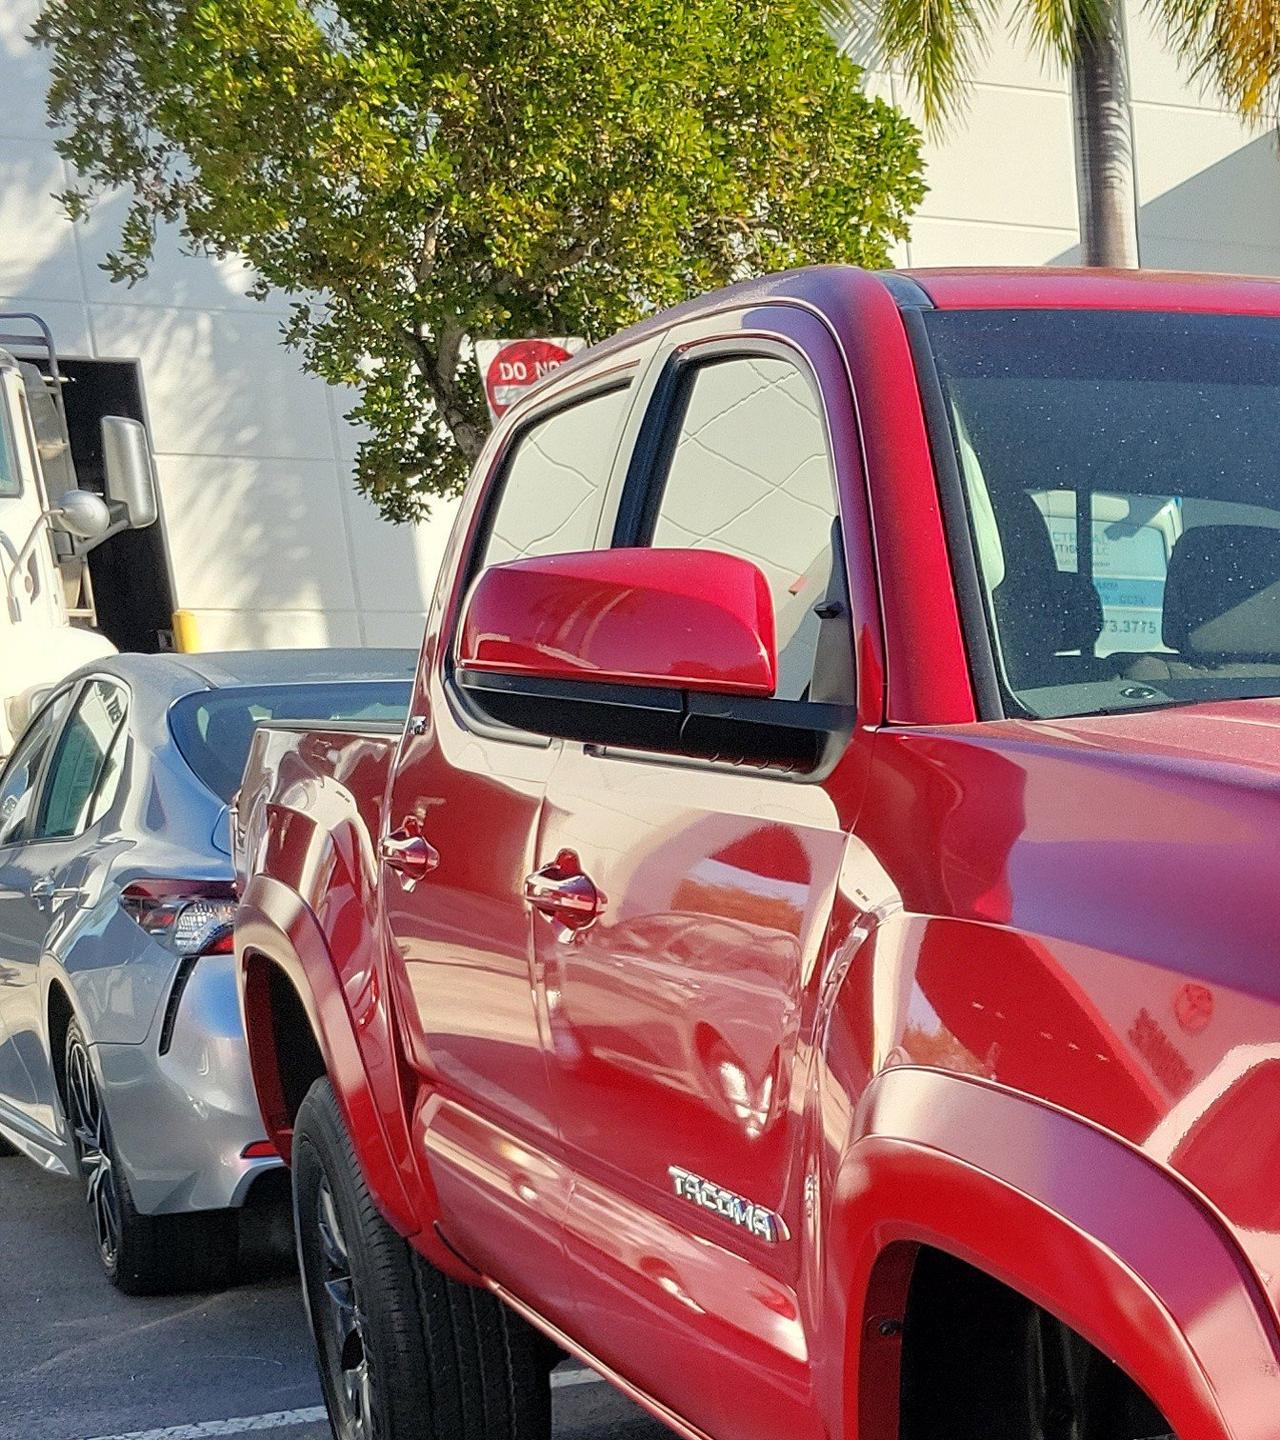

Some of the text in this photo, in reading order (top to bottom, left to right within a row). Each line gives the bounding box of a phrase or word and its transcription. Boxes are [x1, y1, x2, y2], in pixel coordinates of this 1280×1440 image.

[499, 359, 563, 381] DO NO
[667, 1164, 778, 1243] TACOMA
